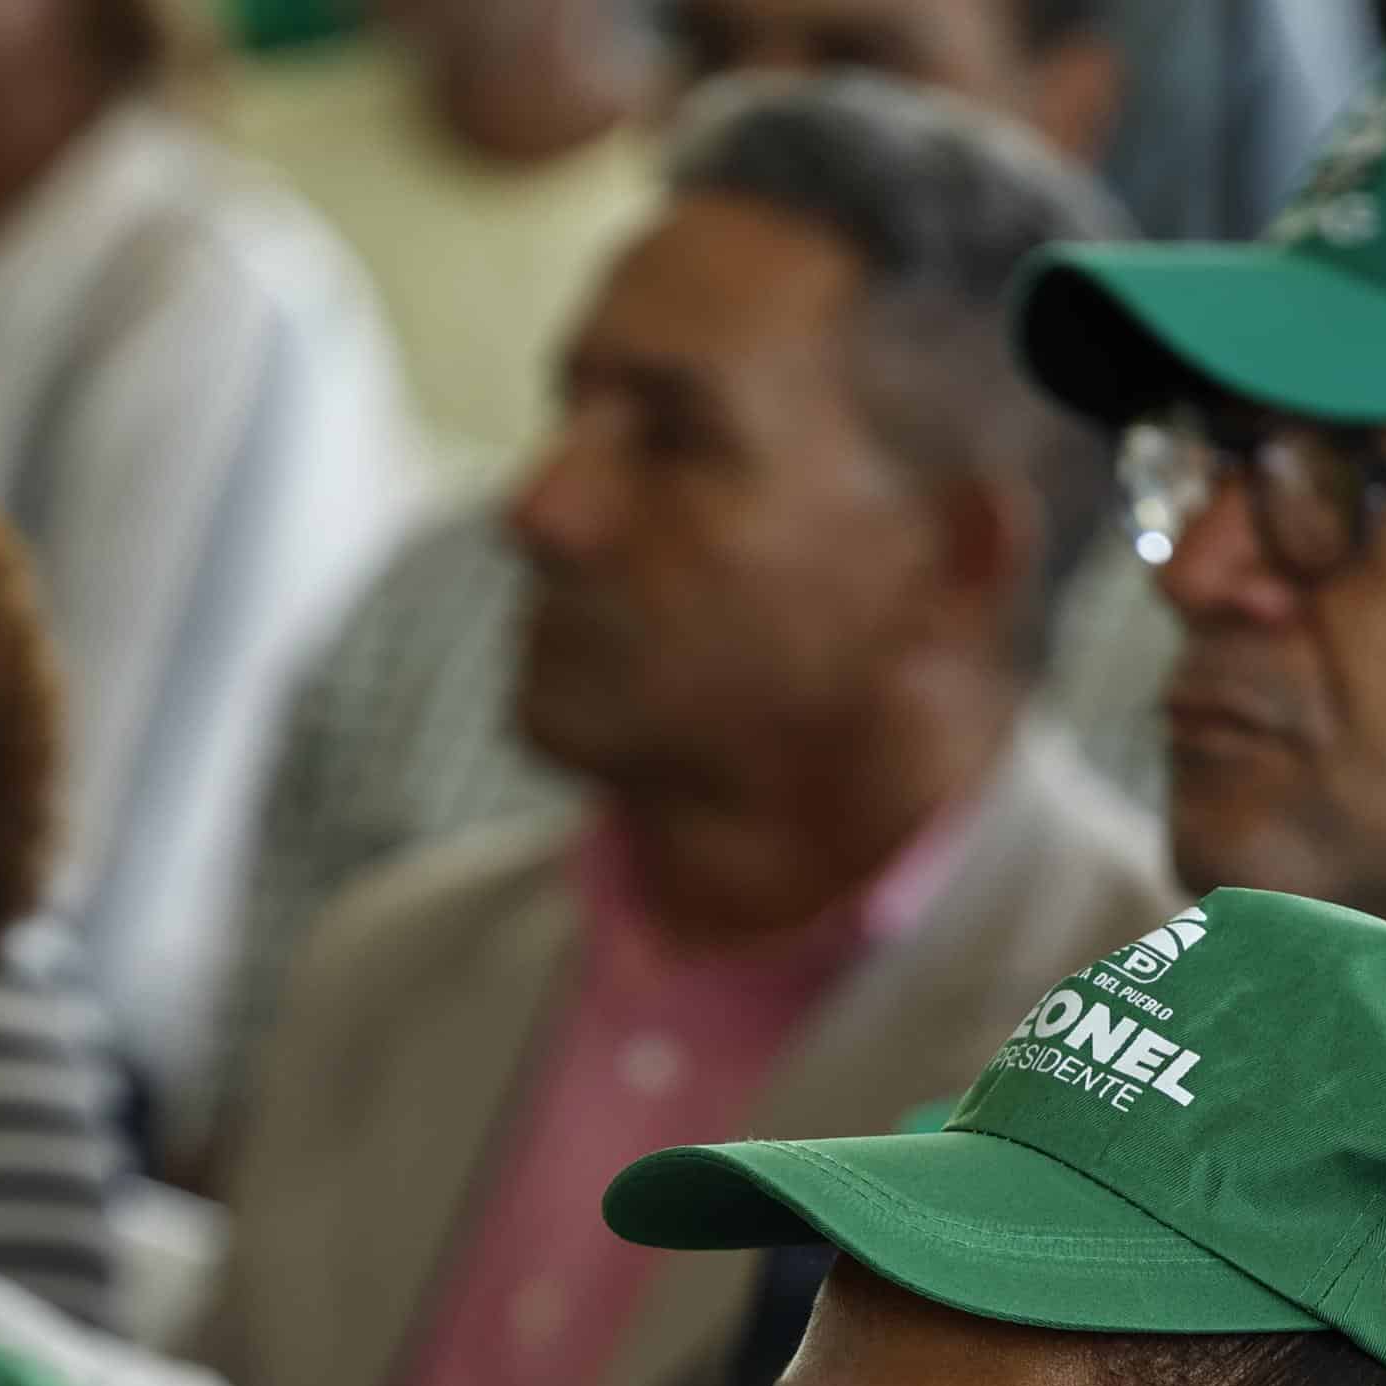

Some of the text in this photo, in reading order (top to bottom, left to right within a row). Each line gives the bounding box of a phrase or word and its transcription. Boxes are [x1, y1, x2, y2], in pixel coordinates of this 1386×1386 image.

[1115, 948, 1157, 973] P
[1093, 972, 1120, 994] DEL
[1118, 985, 1174, 1020] PUEBLO
